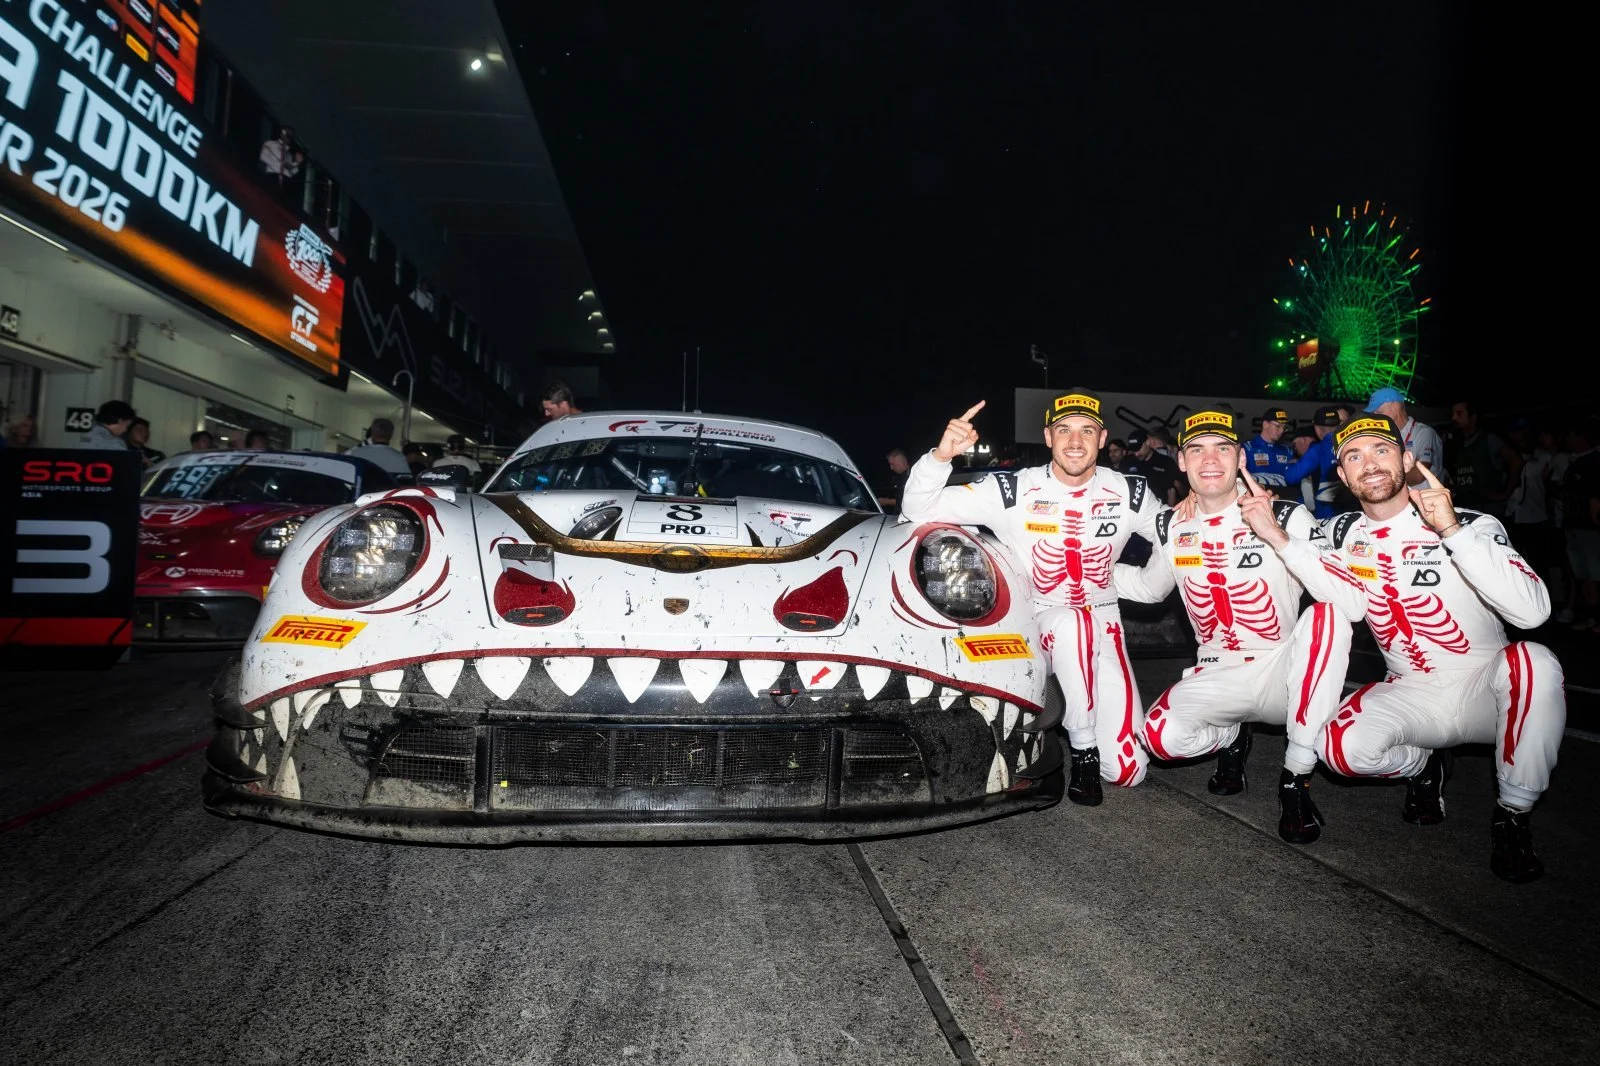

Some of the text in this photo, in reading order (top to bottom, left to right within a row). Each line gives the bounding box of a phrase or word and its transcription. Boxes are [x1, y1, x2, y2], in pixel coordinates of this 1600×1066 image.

[29, 0, 203, 158] CHALLENGE
[55, 69, 260, 268] 1000KM
[32, 147, 130, 232] 2026
[1058, 397, 1096, 408] PIRELLI
[66, 412, 93, 429] 48
[1188, 414, 1228, 427] PIRELLI
[1340, 420, 1384, 438] PIRELLI
[22, 461, 113, 483] SRO
[999, 474, 1014, 500] HRX
[1132, 479, 1143, 506] HRX
[666, 504, 703, 521] 8
[660, 524, 706, 535] PRO
[1027, 523, 1057, 532] PIRELLI
[12, 520, 111, 593] 3
[1175, 557, 1200, 565] PIRELLI
[271, 620, 354, 643] PIRELLI
[964, 639, 1027, 657] PIRELLI
